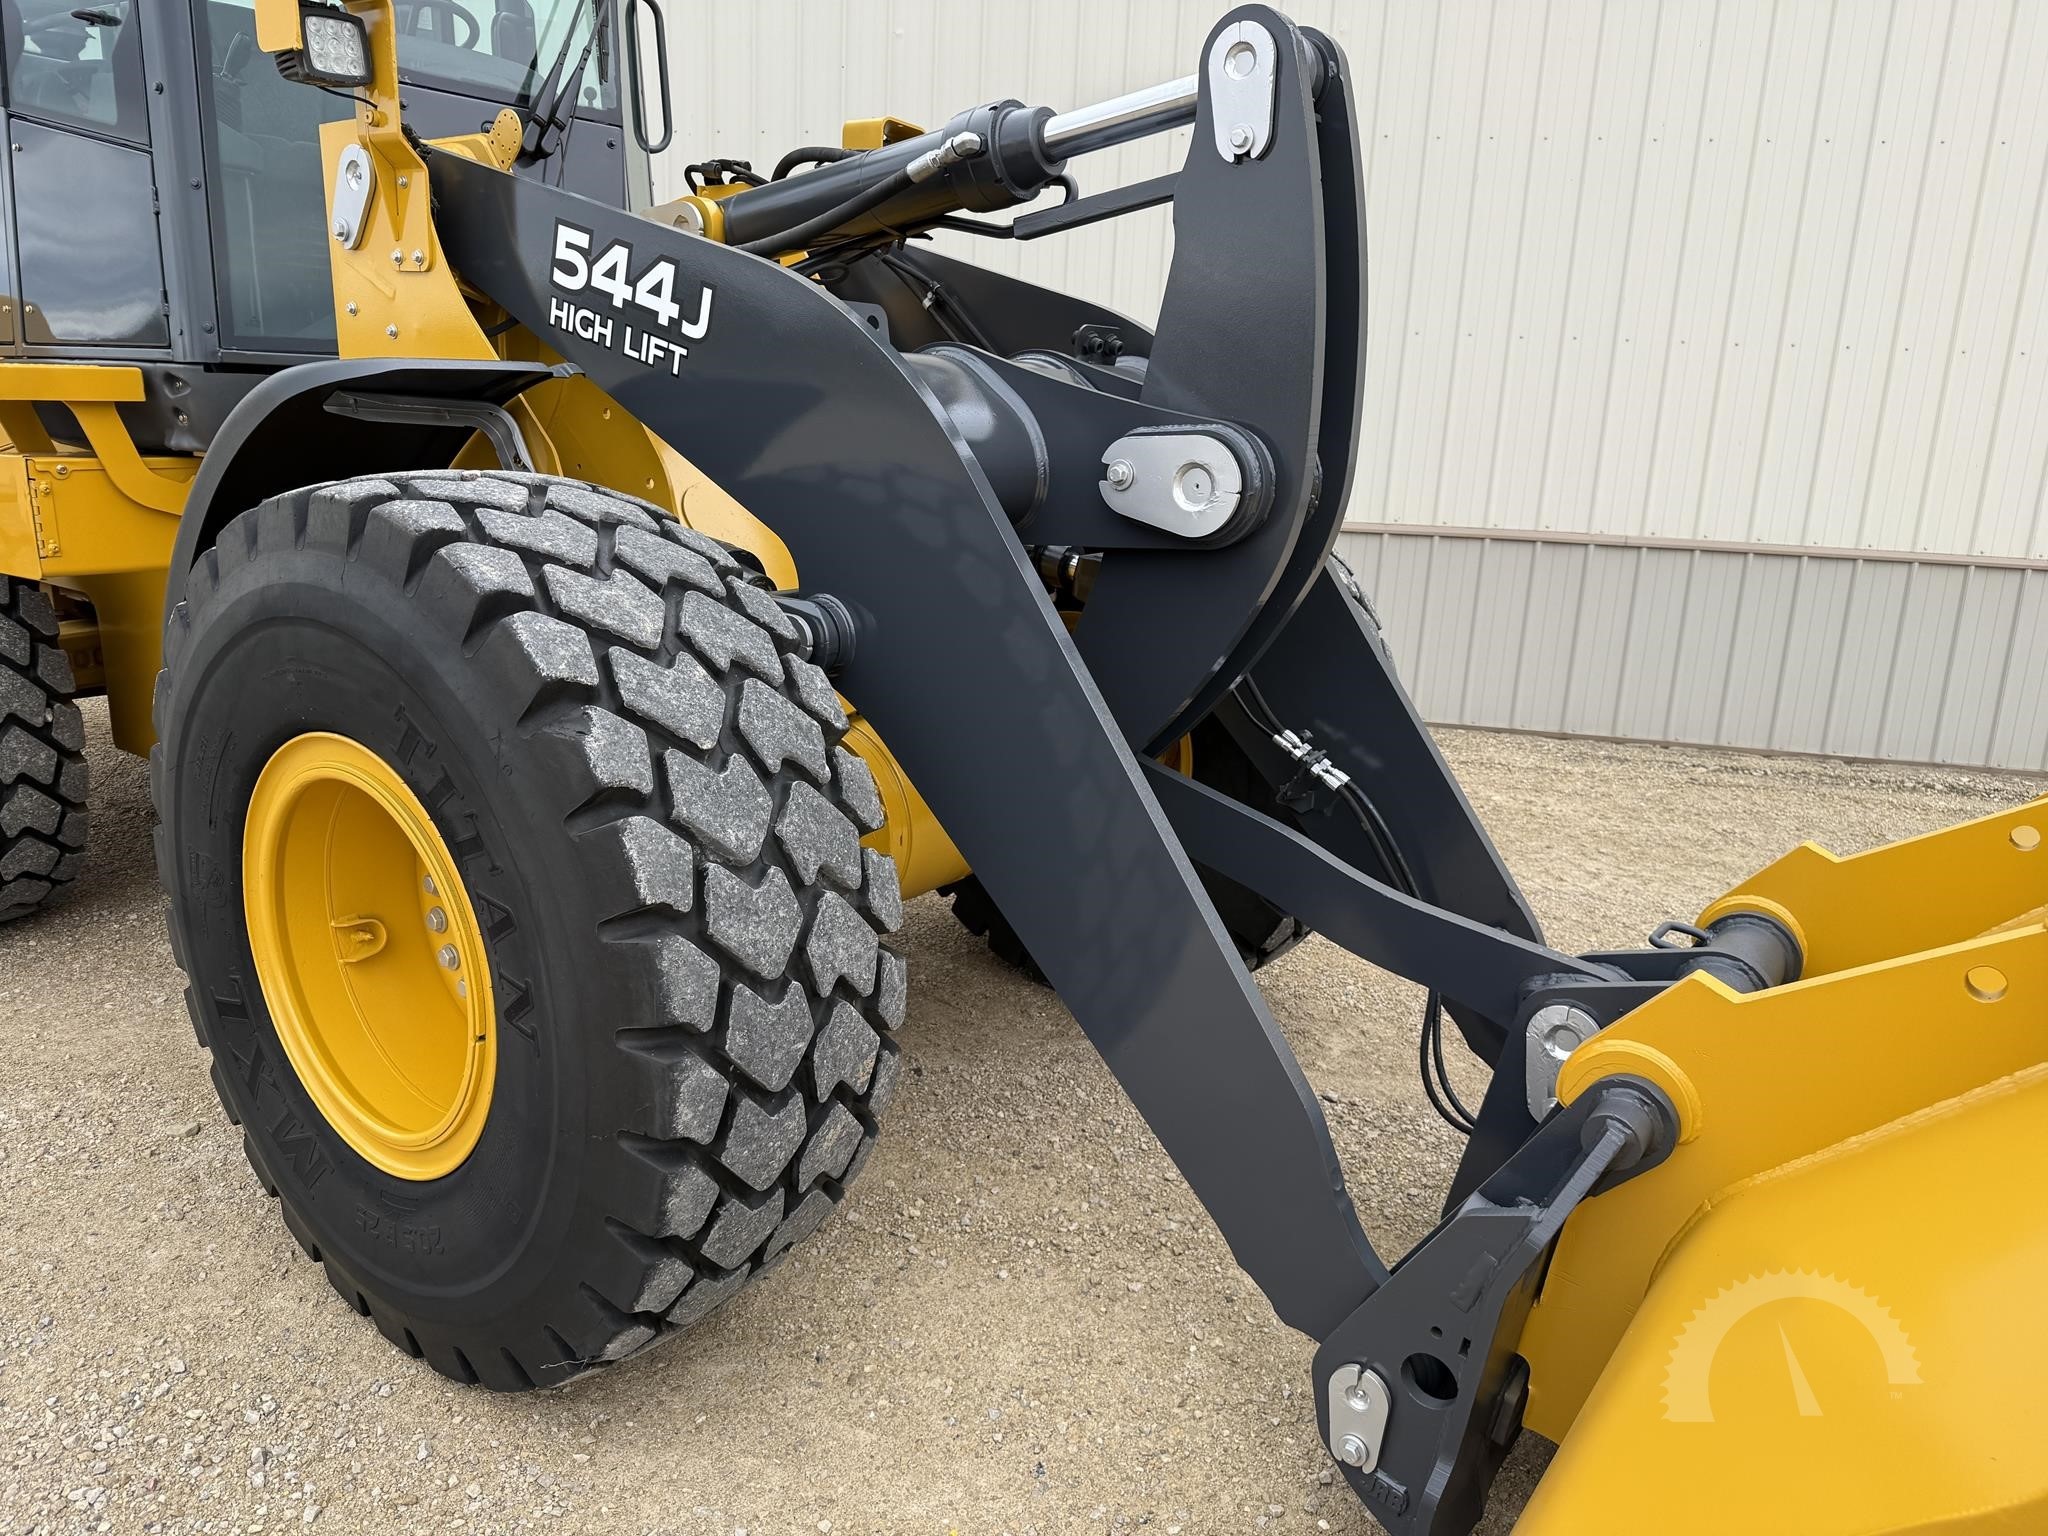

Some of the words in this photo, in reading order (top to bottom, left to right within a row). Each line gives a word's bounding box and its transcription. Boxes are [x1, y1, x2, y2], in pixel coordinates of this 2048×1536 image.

[550, 297, 613, 348] HIGH
[623, 326, 688, 375] LIFT
[552, 224, 713, 340] 544J
[389, 701, 540, 1059] TITAN
